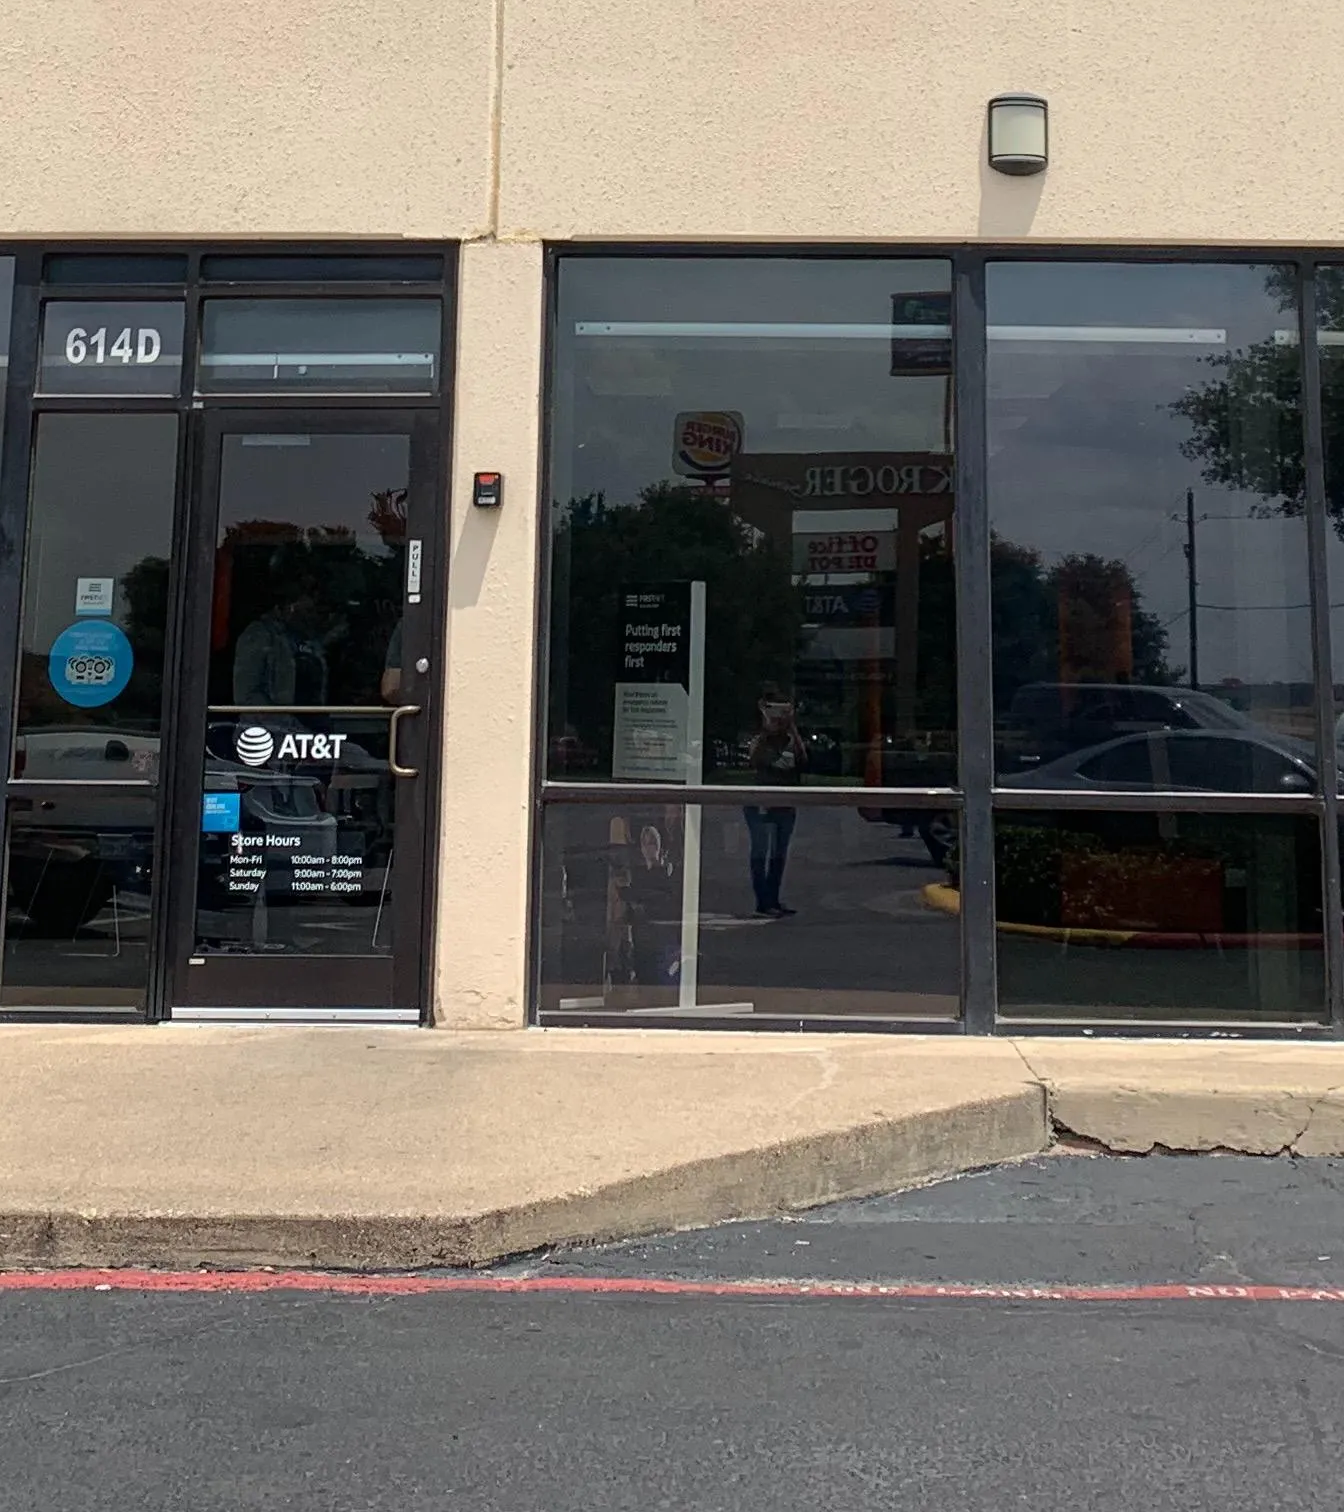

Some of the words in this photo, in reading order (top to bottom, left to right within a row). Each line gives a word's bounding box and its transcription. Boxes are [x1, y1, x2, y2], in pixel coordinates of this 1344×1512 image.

[65, 327, 161, 364] 614D
[411, 544, 419, 577] PULL
[625, 623, 659, 639] Putting
[661, 623, 682, 637] first
[624, 640, 678, 654] responders
[624, 655, 645, 668] first
[277, 733, 348, 760] AT&T
[231, 834, 264, 847] Store
[265, 834, 301, 847] Hours
[229, 854, 263, 865] Mon-Fri
[291, 854, 325, 865] 10:00am
[331, 854, 363, 867] 8:00pm
[229, 868, 267, 879] Saturday
[294, 869, 325, 878] 9:00am
[331, 869, 362, 880] 7:00pm
[229, 881, 260, 893] Sunday
[330, 882, 362, 893] 6:00pm
[1184, 1285, 1248, 1297] NO
